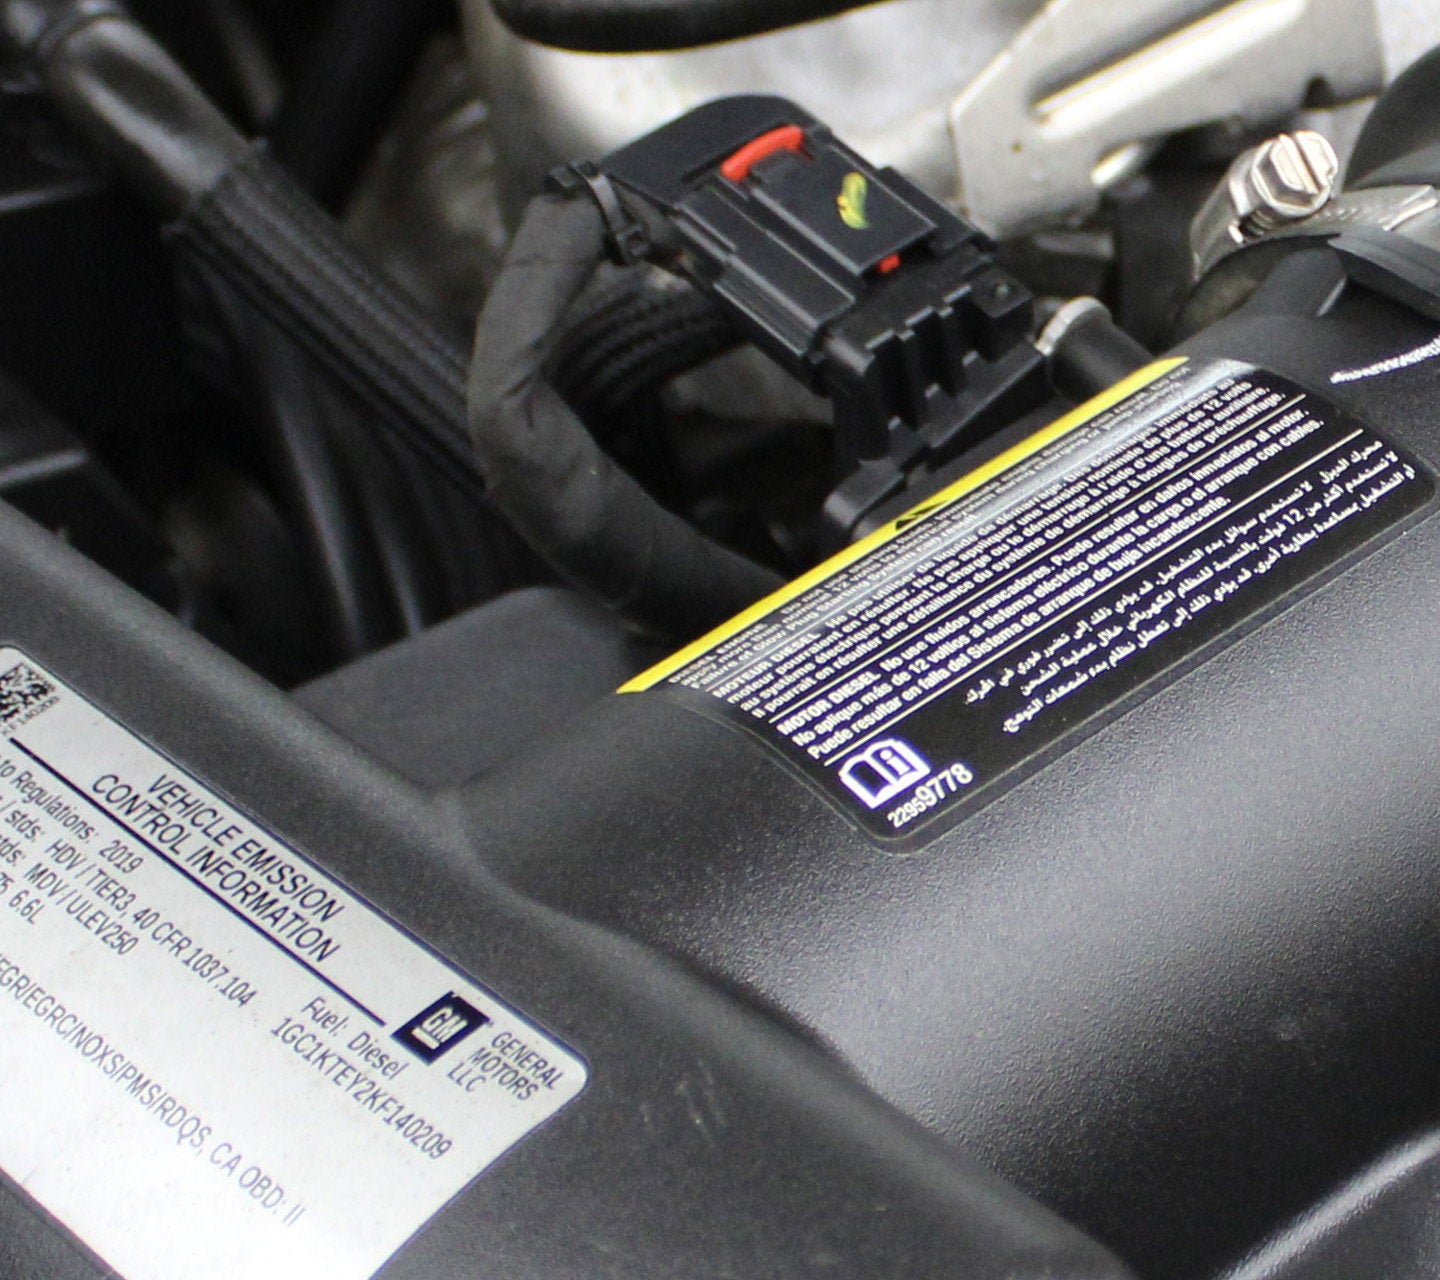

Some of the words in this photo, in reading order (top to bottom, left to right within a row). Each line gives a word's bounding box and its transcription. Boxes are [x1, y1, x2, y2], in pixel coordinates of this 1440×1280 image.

[777, 699, 831, 734] MOTOR
[827, 671, 880, 703] DIESEL
[879, 656, 903, 671] No
[900, 640, 928, 660] use
[923, 615, 970, 644] fluidos
[968, 565, 1055, 618] arrancadores.
[1050, 538, 1093, 566] Puede
[1091, 509, 1139, 542] resultar
[1137, 499, 1158, 514] en
[1154, 477, 1193, 503] daños
[1189, 439, 1257, 480] inmediatos
[1254, 429, 1271, 442] al
[1267, 409, 1309, 434] motor.
[791, 730, 816, 746] No
[813, 701, 862, 734] aplique
[860, 682, 893, 705] más
[890, 670, 911, 686] de
[907, 657, 930, 673] 12
[926, 634, 970, 663] voltios
[968, 623, 985, 638] al
[982, 594, 1036, 629] sistema
[1033, 561, 1089, 598] eléctrico
[1086, 532, 1135, 565] durante
[1129, 524, 1149, 536] la
[1145, 502, 1184, 528] carga
[1180, 496, 1194, 507] o
[1190, 487, 1207, 501] el
[1203, 456, 1258, 493] arranque
[1255, 442, 1282, 461] con
[1278, 419, 1324, 446] cables.
[807, 728, 853, 759] Puede
[850, 696, 902, 733] resultar
[900, 684, 922, 701] en
[917, 667, 950, 689] falla
[947, 652, 971, 672] del
[966, 622, 1023, 659] Sistema
[1019, 611, 1041, 627] de
[1038, 577, 1095, 616] arranque
[1092, 566, 1113, 582] de
[1137, 496, 1230, 552] incandescente.
[10, 770, 97, 842] Regulations:
[98, 839, 143, 873] 2019
[887, 763, 972, 827] 22959778
[92, 774, 190, 854] CONTROL
[187, 846, 338, 961] INFORMATION
[148, 774, 242, 846] VEHICLE
[231, 839, 343, 921] EMISSION
[4, 809, 44, 841] stds:
[44, 838, 87, 870] HDV
[85, 868, 136, 916] TIER3,
[132, 907, 160, 930] 40
[150, 921, 192, 957] CFR
[182, 947, 256, 1006] 1037.104
[8, 889, 44, 924] 6.6L
[23, 862, 69, 897] MDV
[65, 894, 138, 955] ULEV250
[301, 996, 348, 1036] Fuel:
[346, 1031, 408, 1079] Diesel
[421, 1006, 469, 1043] GM
[491, 1032, 561, 1089] GENERAL
[446, 1062, 484, 1092] LLC
[469, 1047, 537, 1100] MOTORS
[209, 1142, 242, 1175] CA
[238, 1165, 283, 1207] OBD:
[283, 1204, 304, 1223] II
